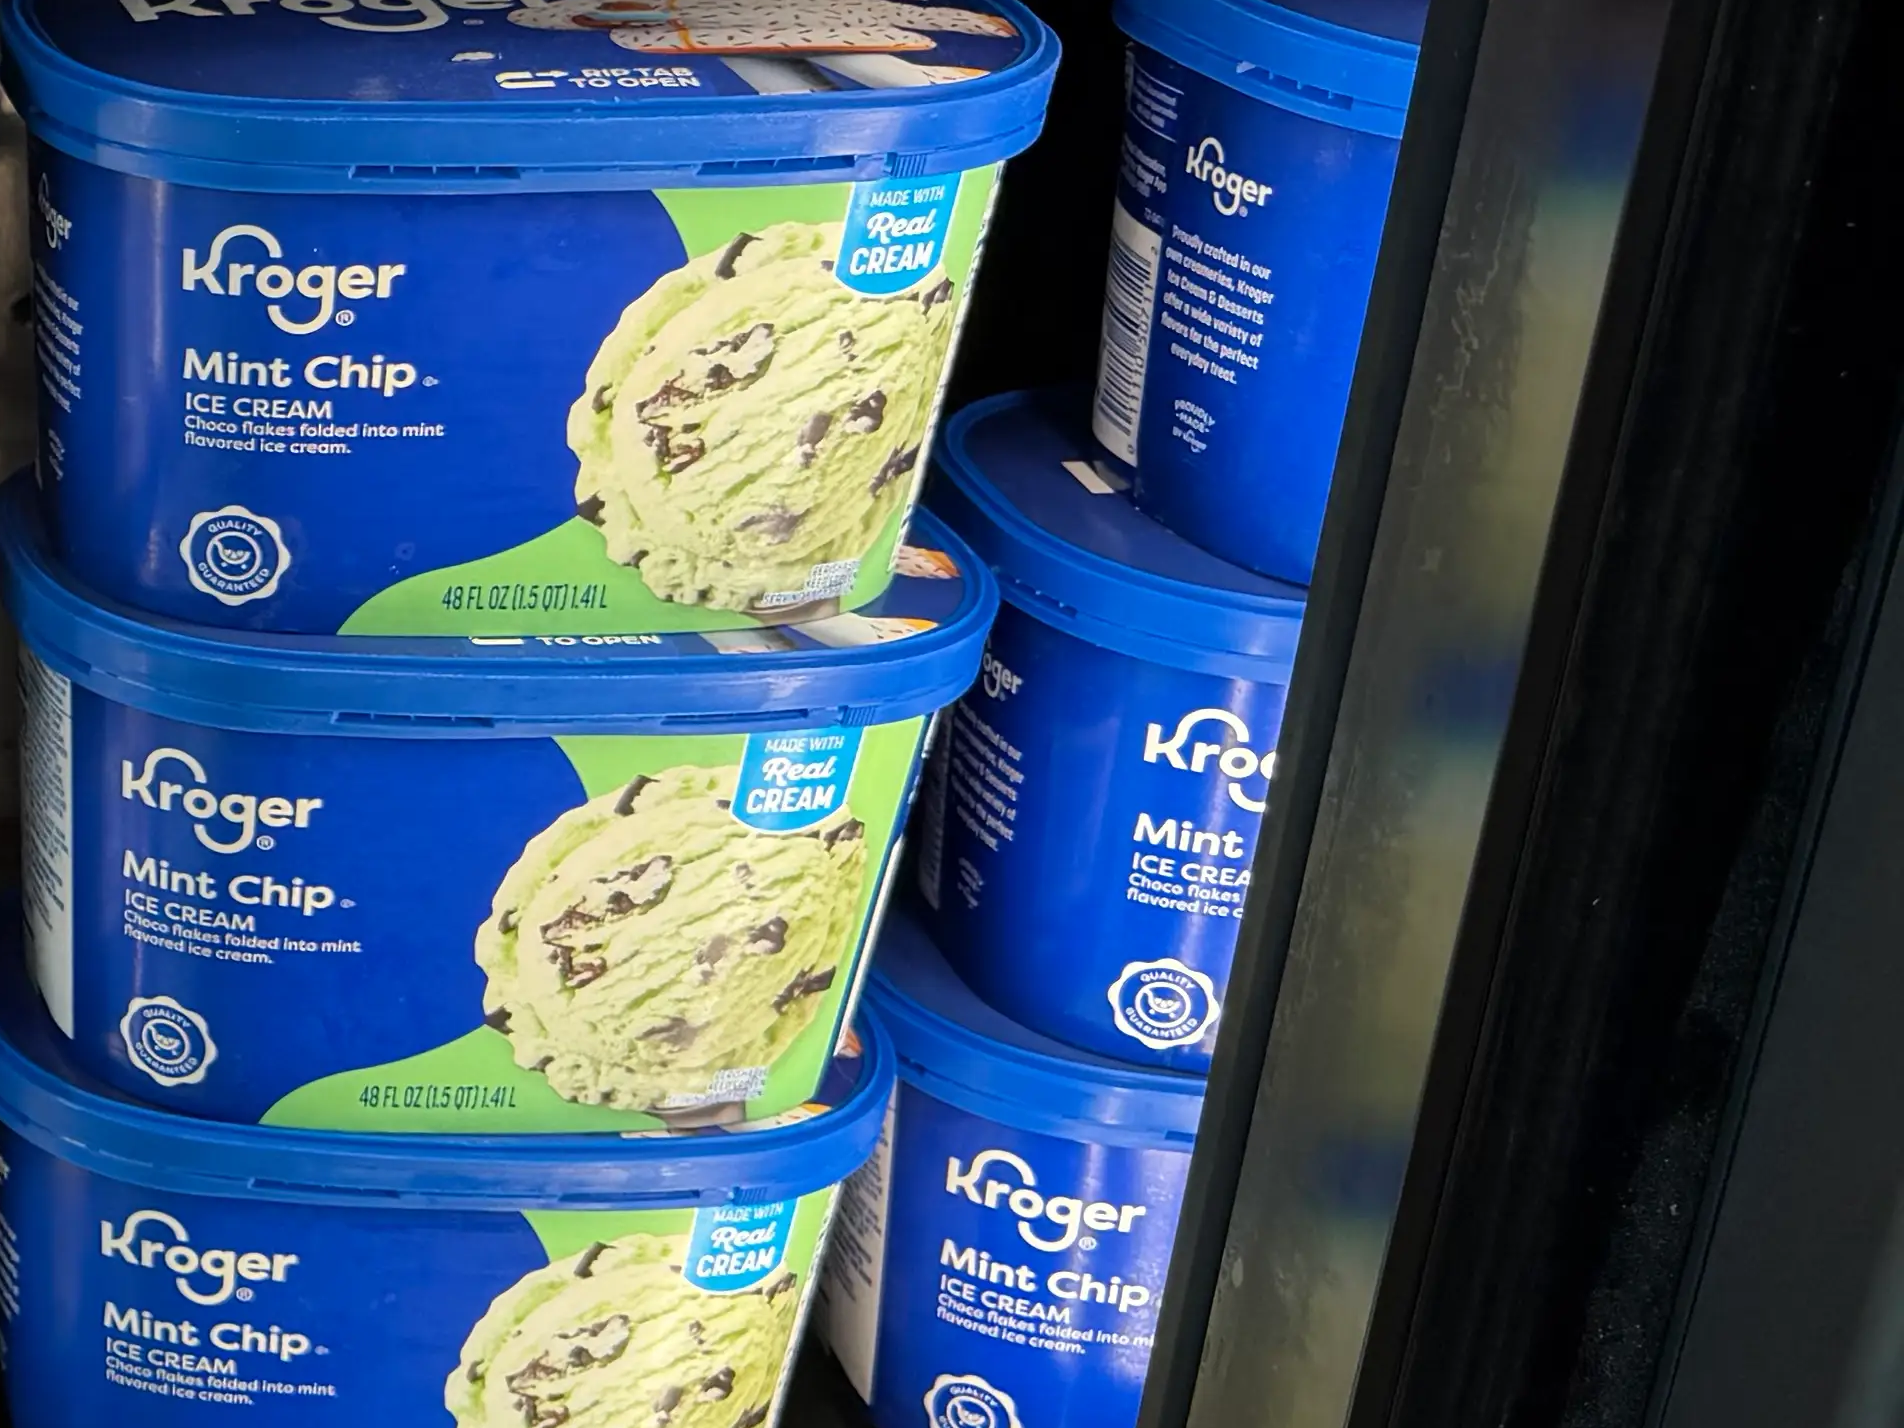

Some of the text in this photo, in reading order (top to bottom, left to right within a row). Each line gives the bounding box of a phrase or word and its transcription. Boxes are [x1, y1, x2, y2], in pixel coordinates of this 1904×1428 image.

[1186, 138, 1273, 217] Kroger
[181, 224, 406, 334] Kroger
[850, 241, 936, 275] CREAM
[183, 348, 417, 398] Mint Chip
[122, 748, 322, 854] Kroger
[122, 849, 335, 914] Mint Chip
[945, 1149, 1147, 1253] Kroger
[940, 1239, 1150, 1312] Mint Chip
